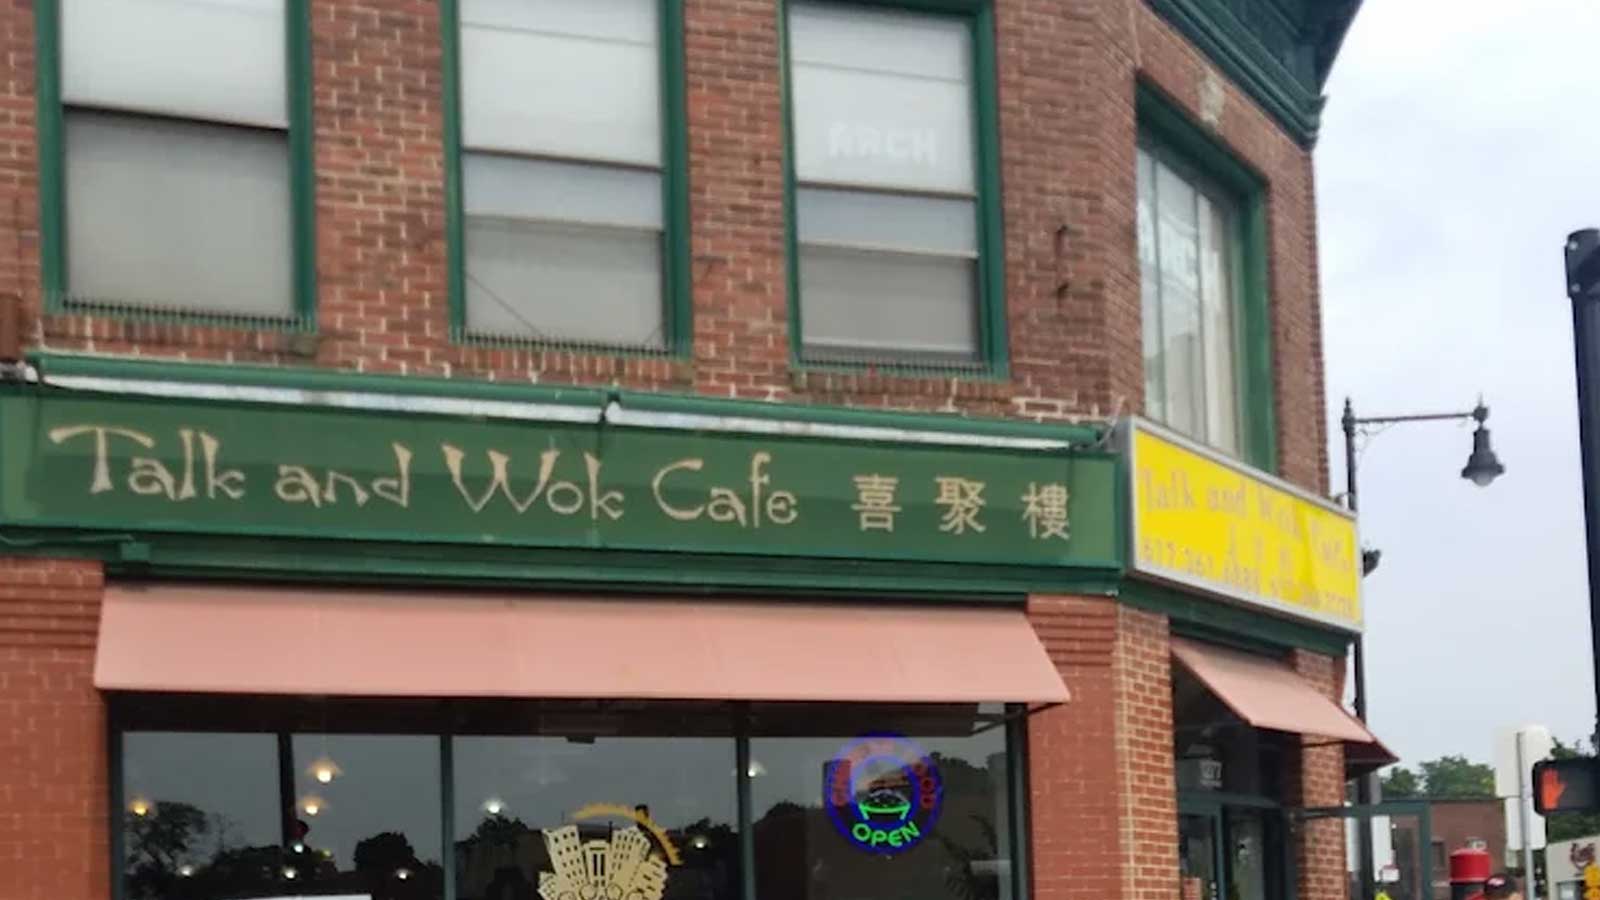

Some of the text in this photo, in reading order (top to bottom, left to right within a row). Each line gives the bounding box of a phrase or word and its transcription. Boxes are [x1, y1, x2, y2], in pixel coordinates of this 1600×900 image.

[49, 425, 798, 528] Talk and Wok Cafe
[852, 821, 920, 847] OPEN
